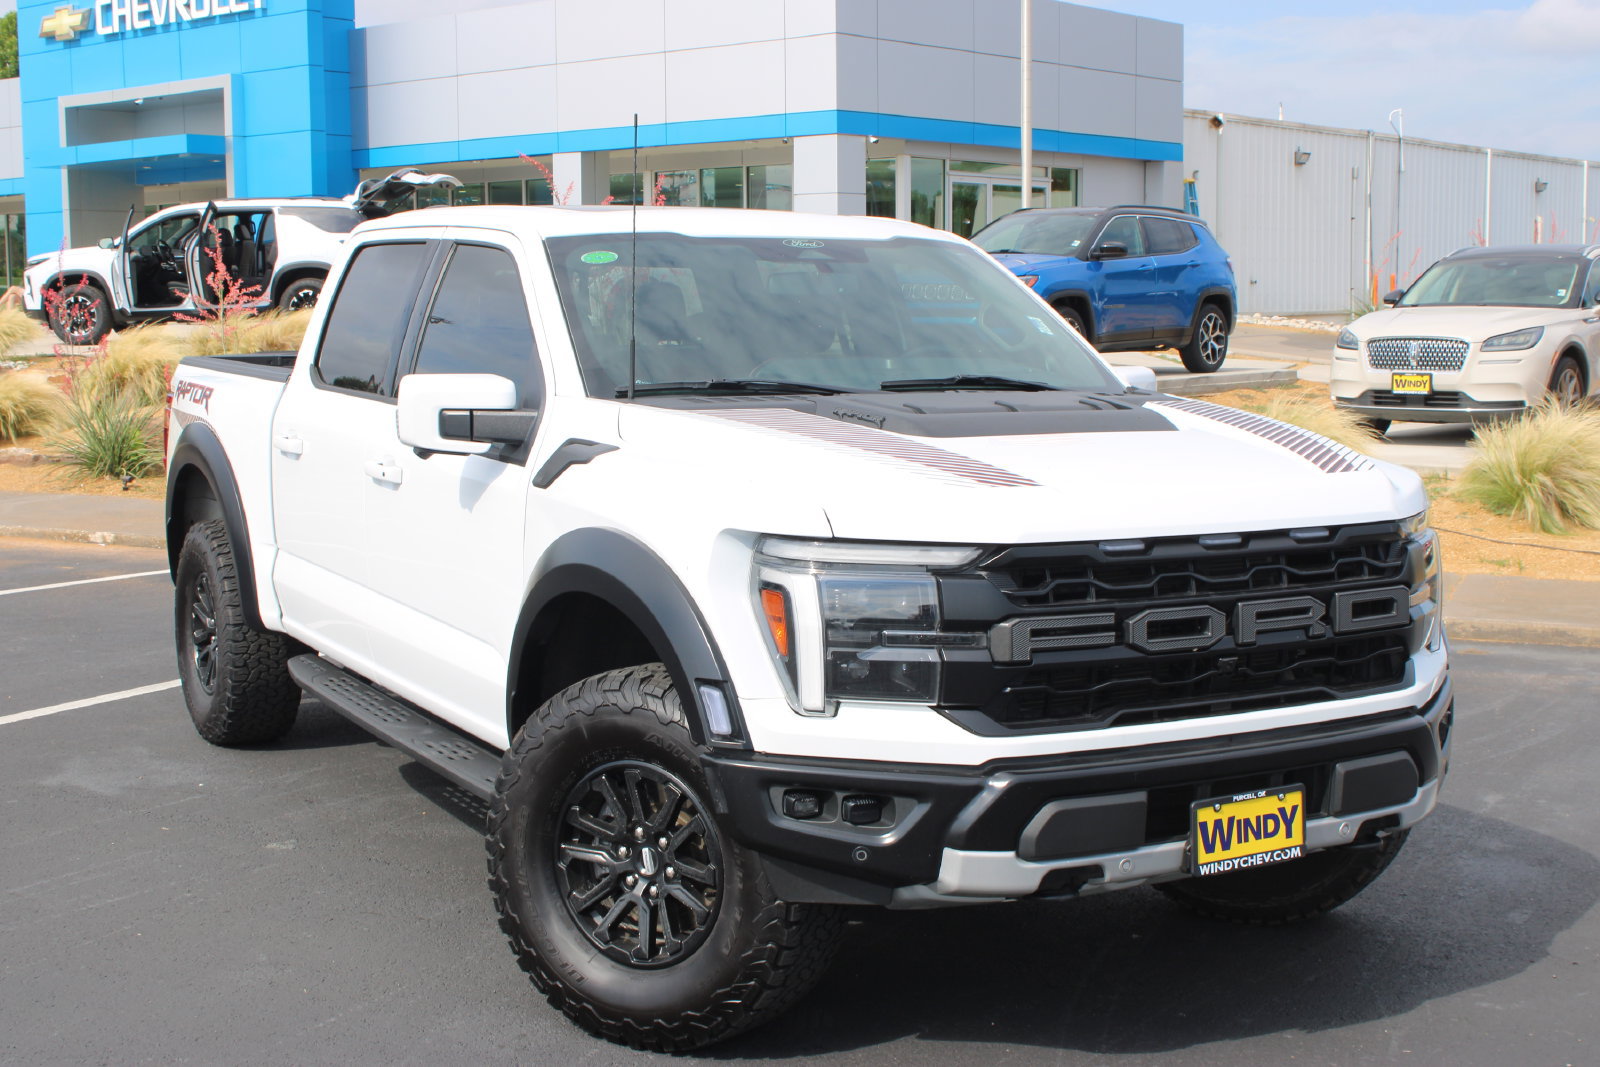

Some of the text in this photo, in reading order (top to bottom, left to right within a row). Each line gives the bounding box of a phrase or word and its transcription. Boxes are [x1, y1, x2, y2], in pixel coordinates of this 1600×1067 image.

[95, 0, 263, 36] CHEVRO
[790, 239, 819, 247] Ford
[176, 380, 214, 415] RAPTOR
[1394, 379, 1428, 388] WINDY
[989, 585, 1409, 665] FORD
[1232, 790, 1267, 802] PURCELL, OK
[1199, 805, 1299, 854] WINDY
[1199, 846, 1301, 875] WINDYCHEV.COM
